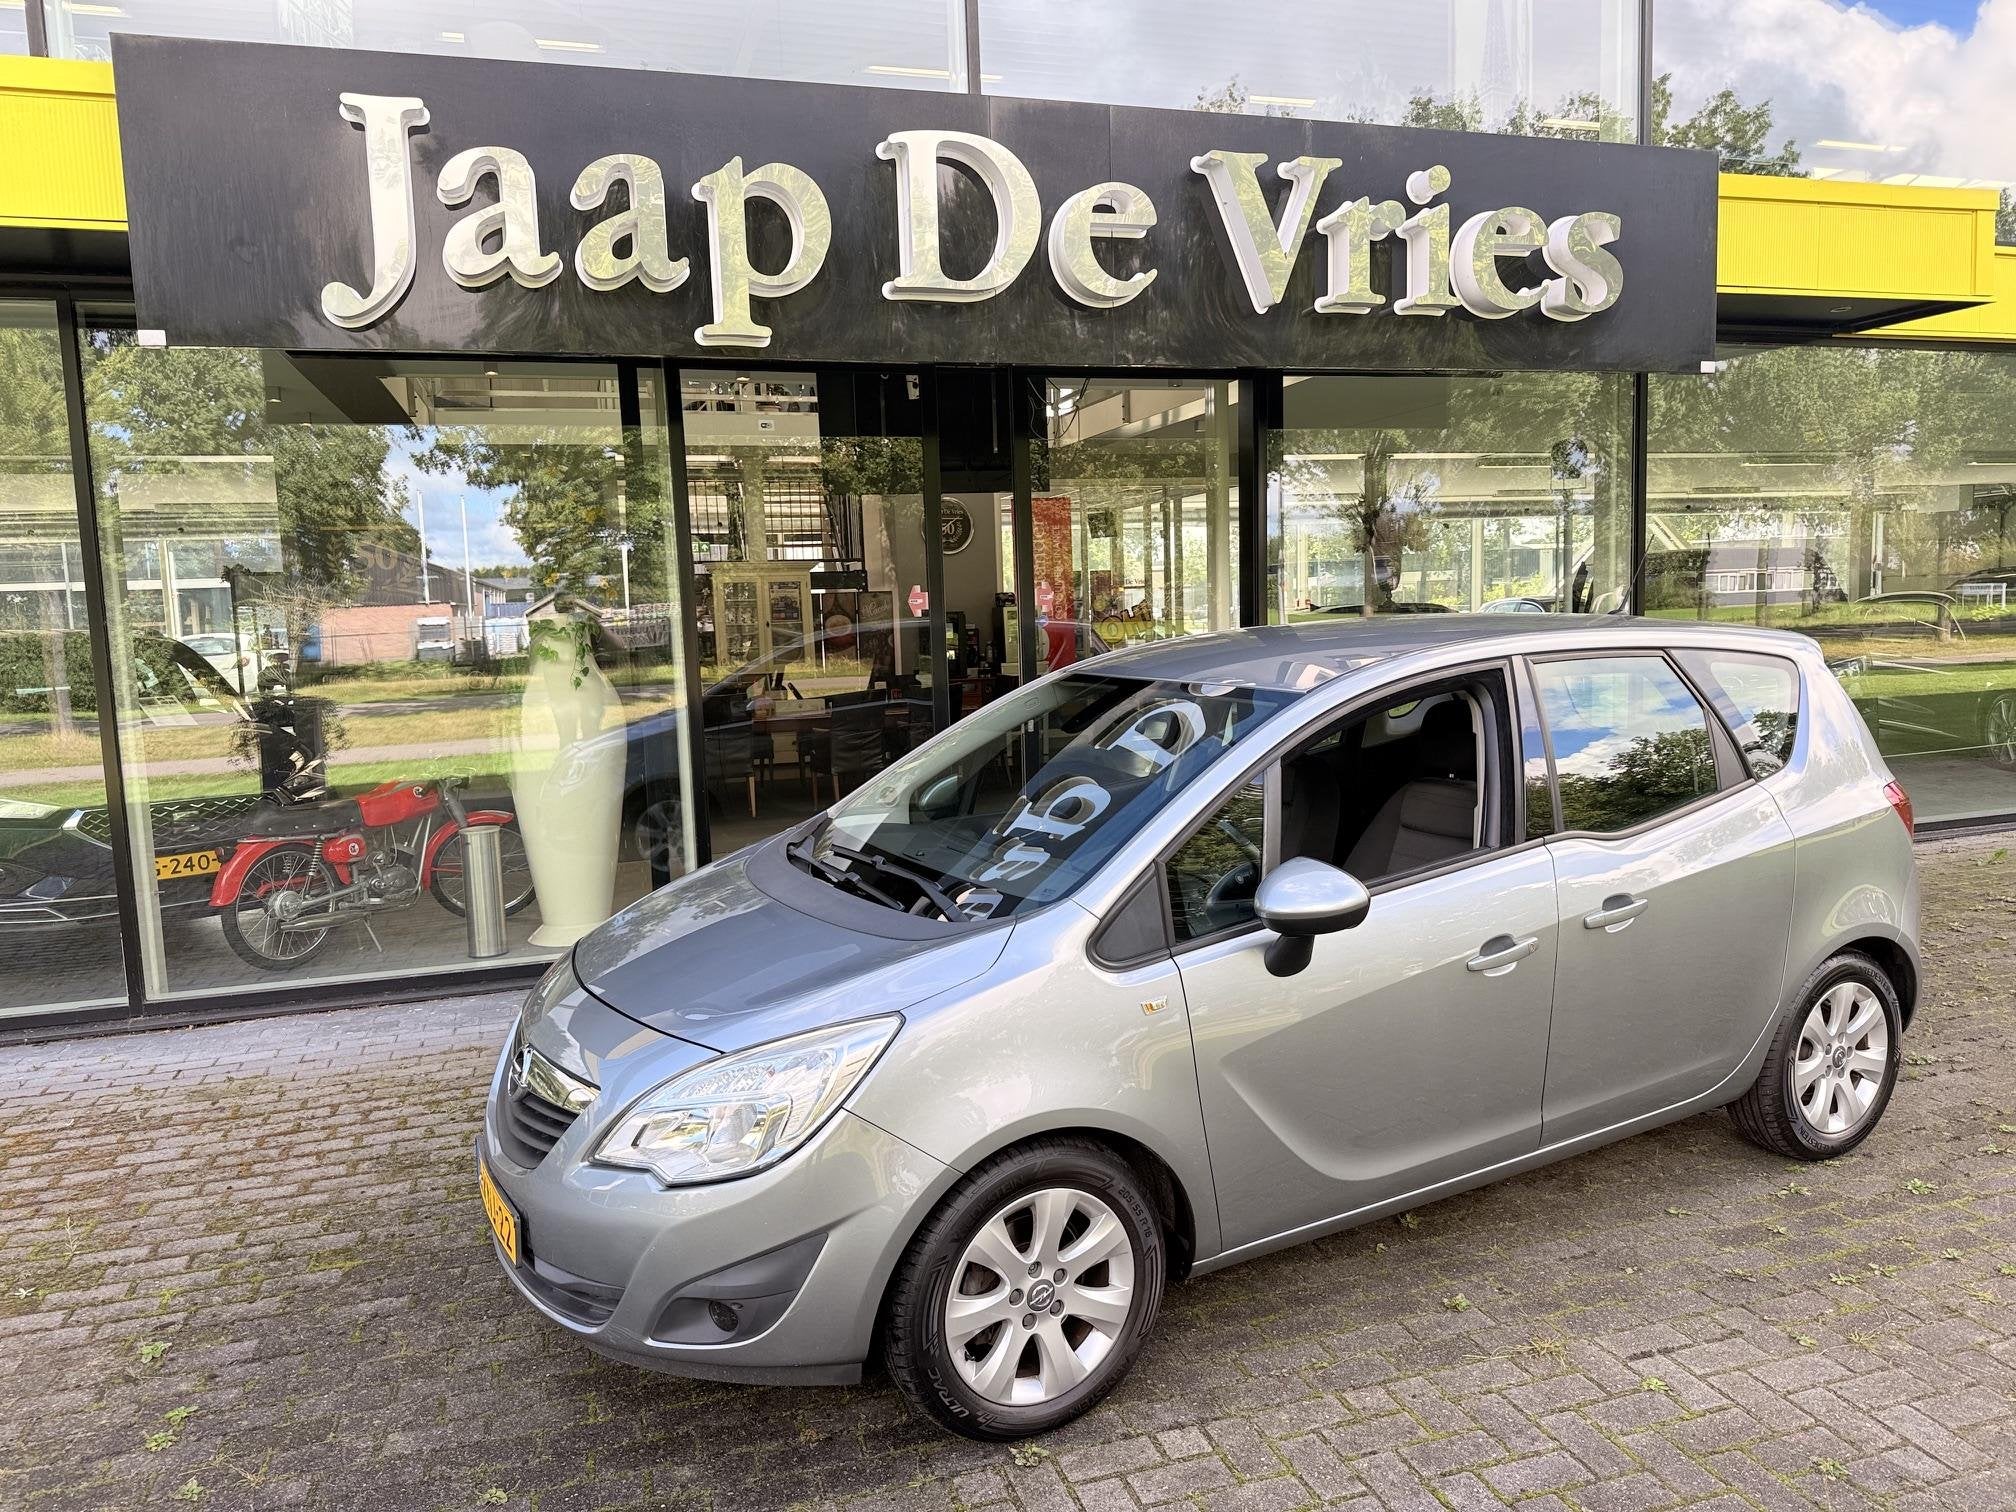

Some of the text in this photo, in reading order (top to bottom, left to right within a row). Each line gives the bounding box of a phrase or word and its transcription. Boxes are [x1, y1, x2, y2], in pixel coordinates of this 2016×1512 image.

[321, 93, 1623, 347] Jaap De Vries
[1052, 525, 1062, 563] FINANCE
[1118, 1186, 1144, 1216] 205/55
[927, 1366, 971, 1419] ULTRAC
